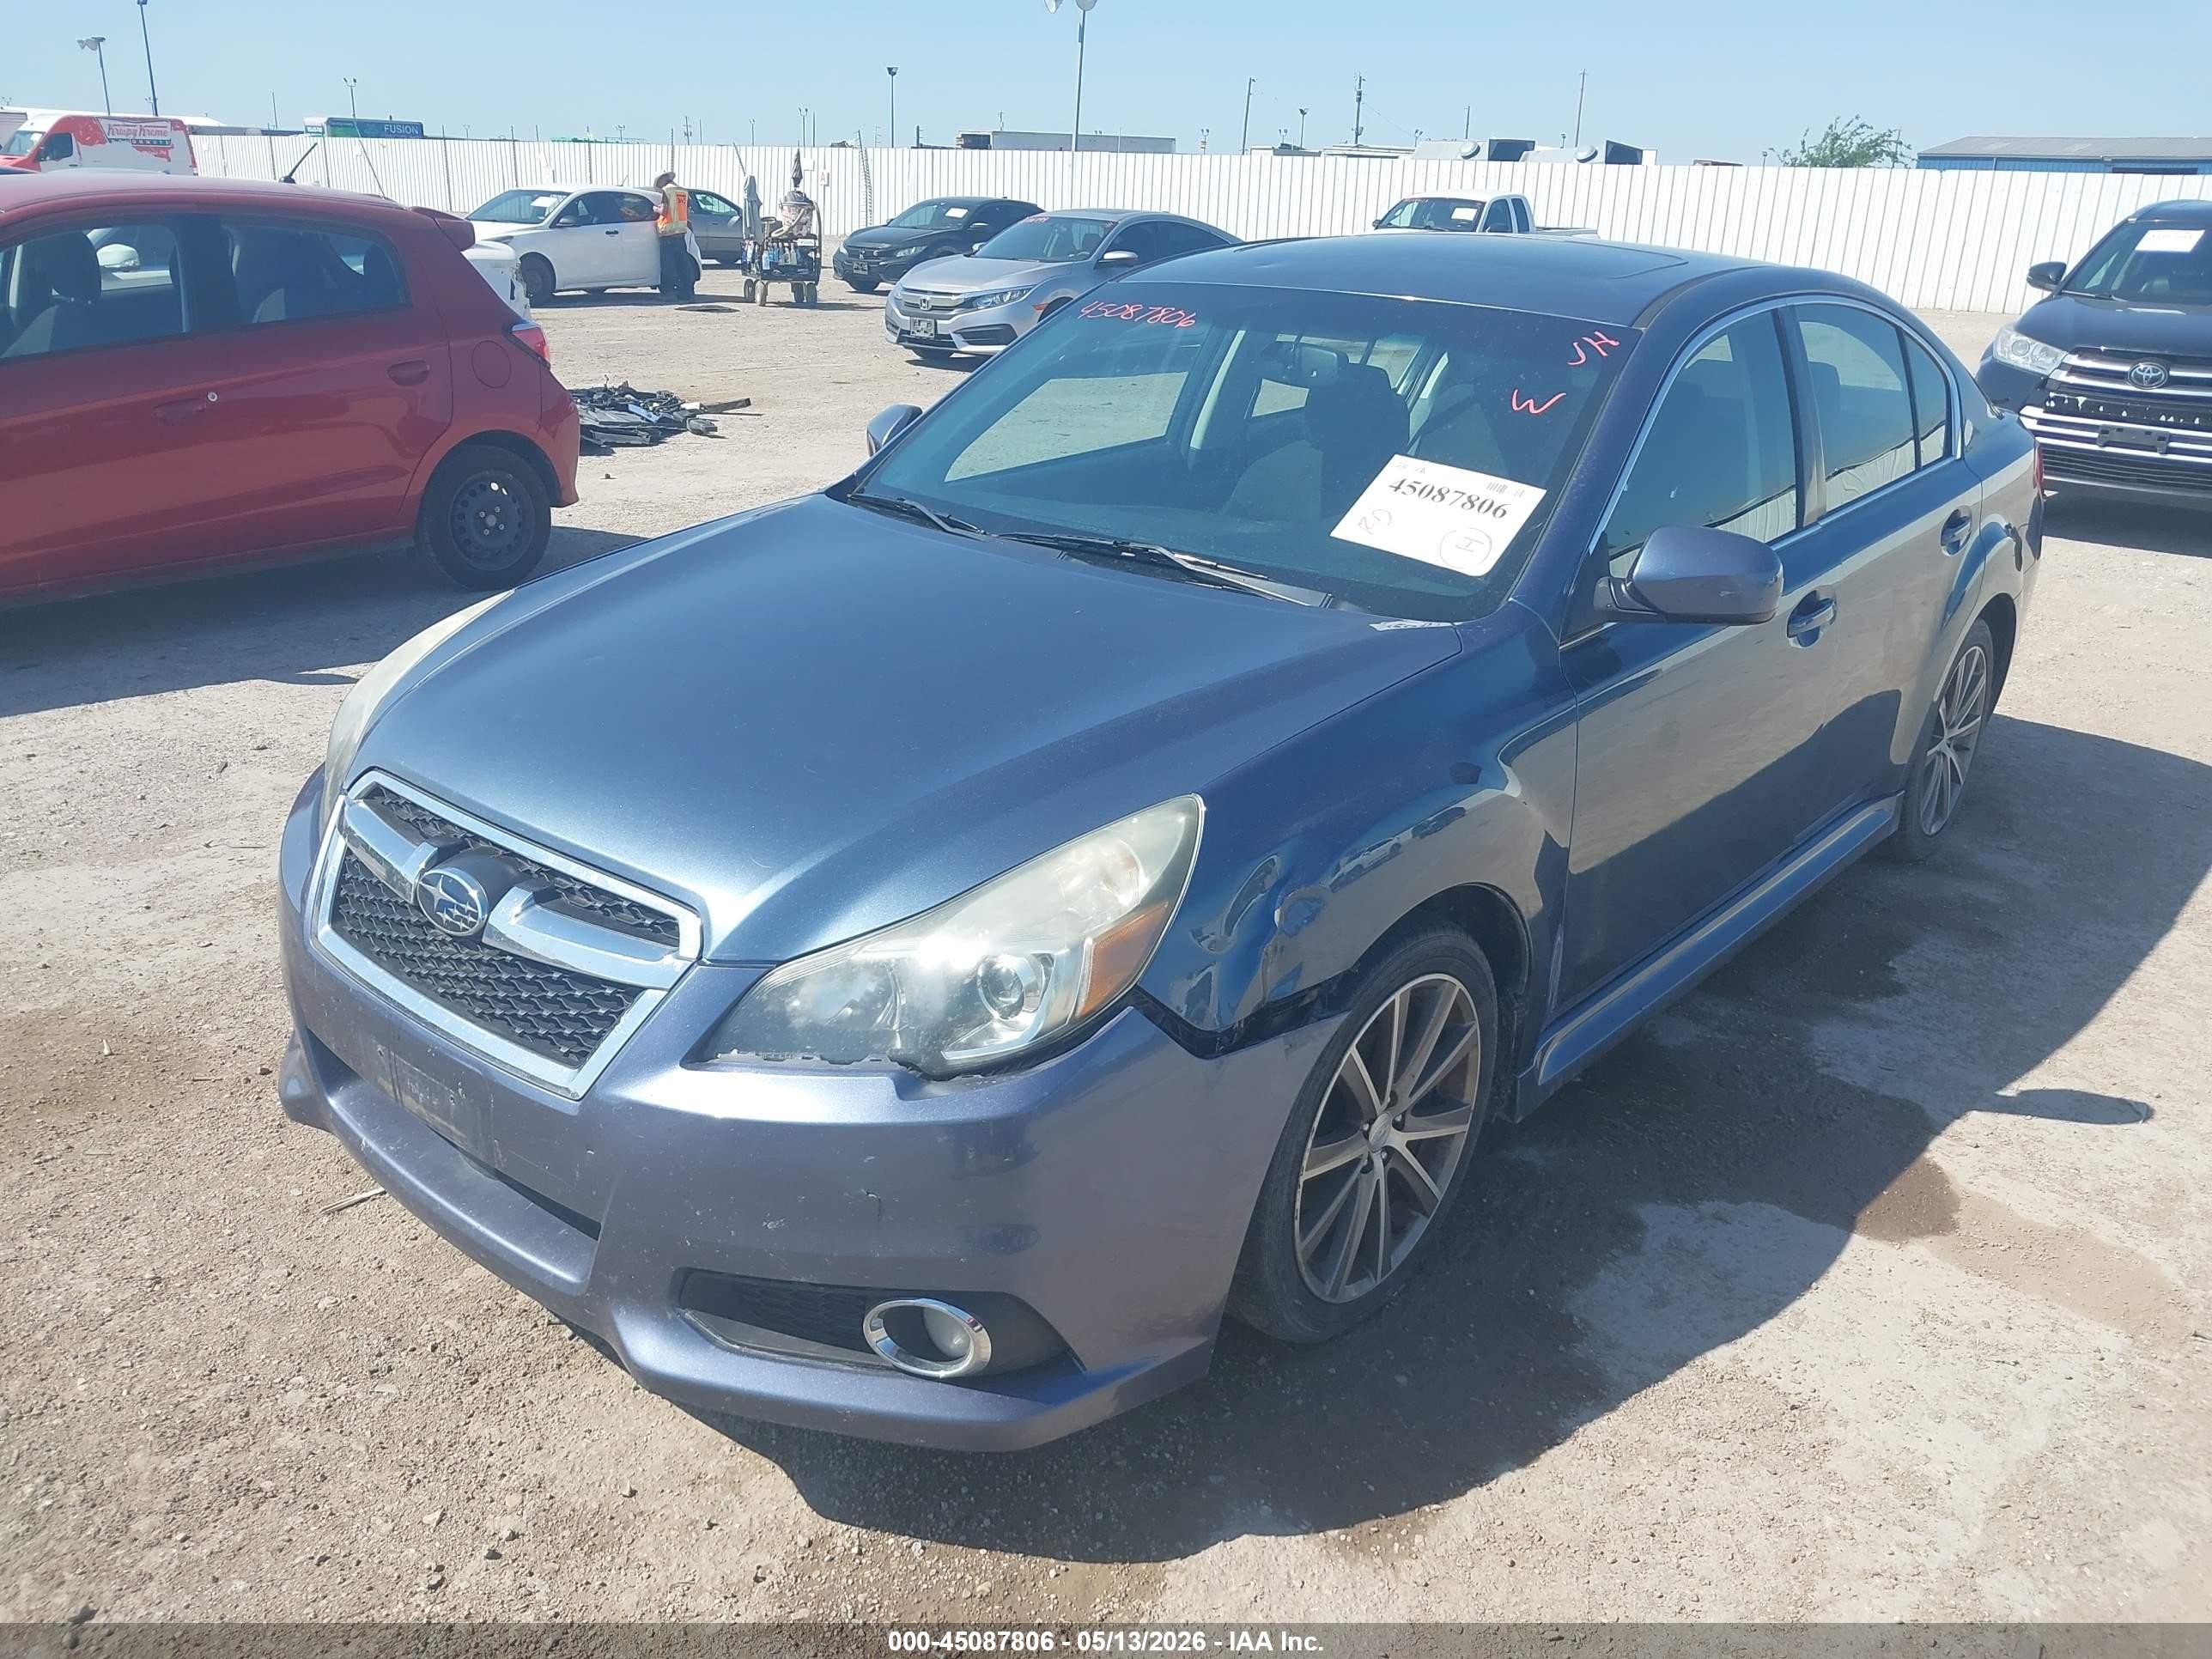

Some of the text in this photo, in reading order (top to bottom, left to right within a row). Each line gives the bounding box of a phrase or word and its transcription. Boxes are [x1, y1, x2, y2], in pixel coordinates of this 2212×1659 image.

[384, 124, 419, 135] FUSION
[1078, 301, 1196, 328] 45087806
[1388, 477, 1511, 520] 45087806
